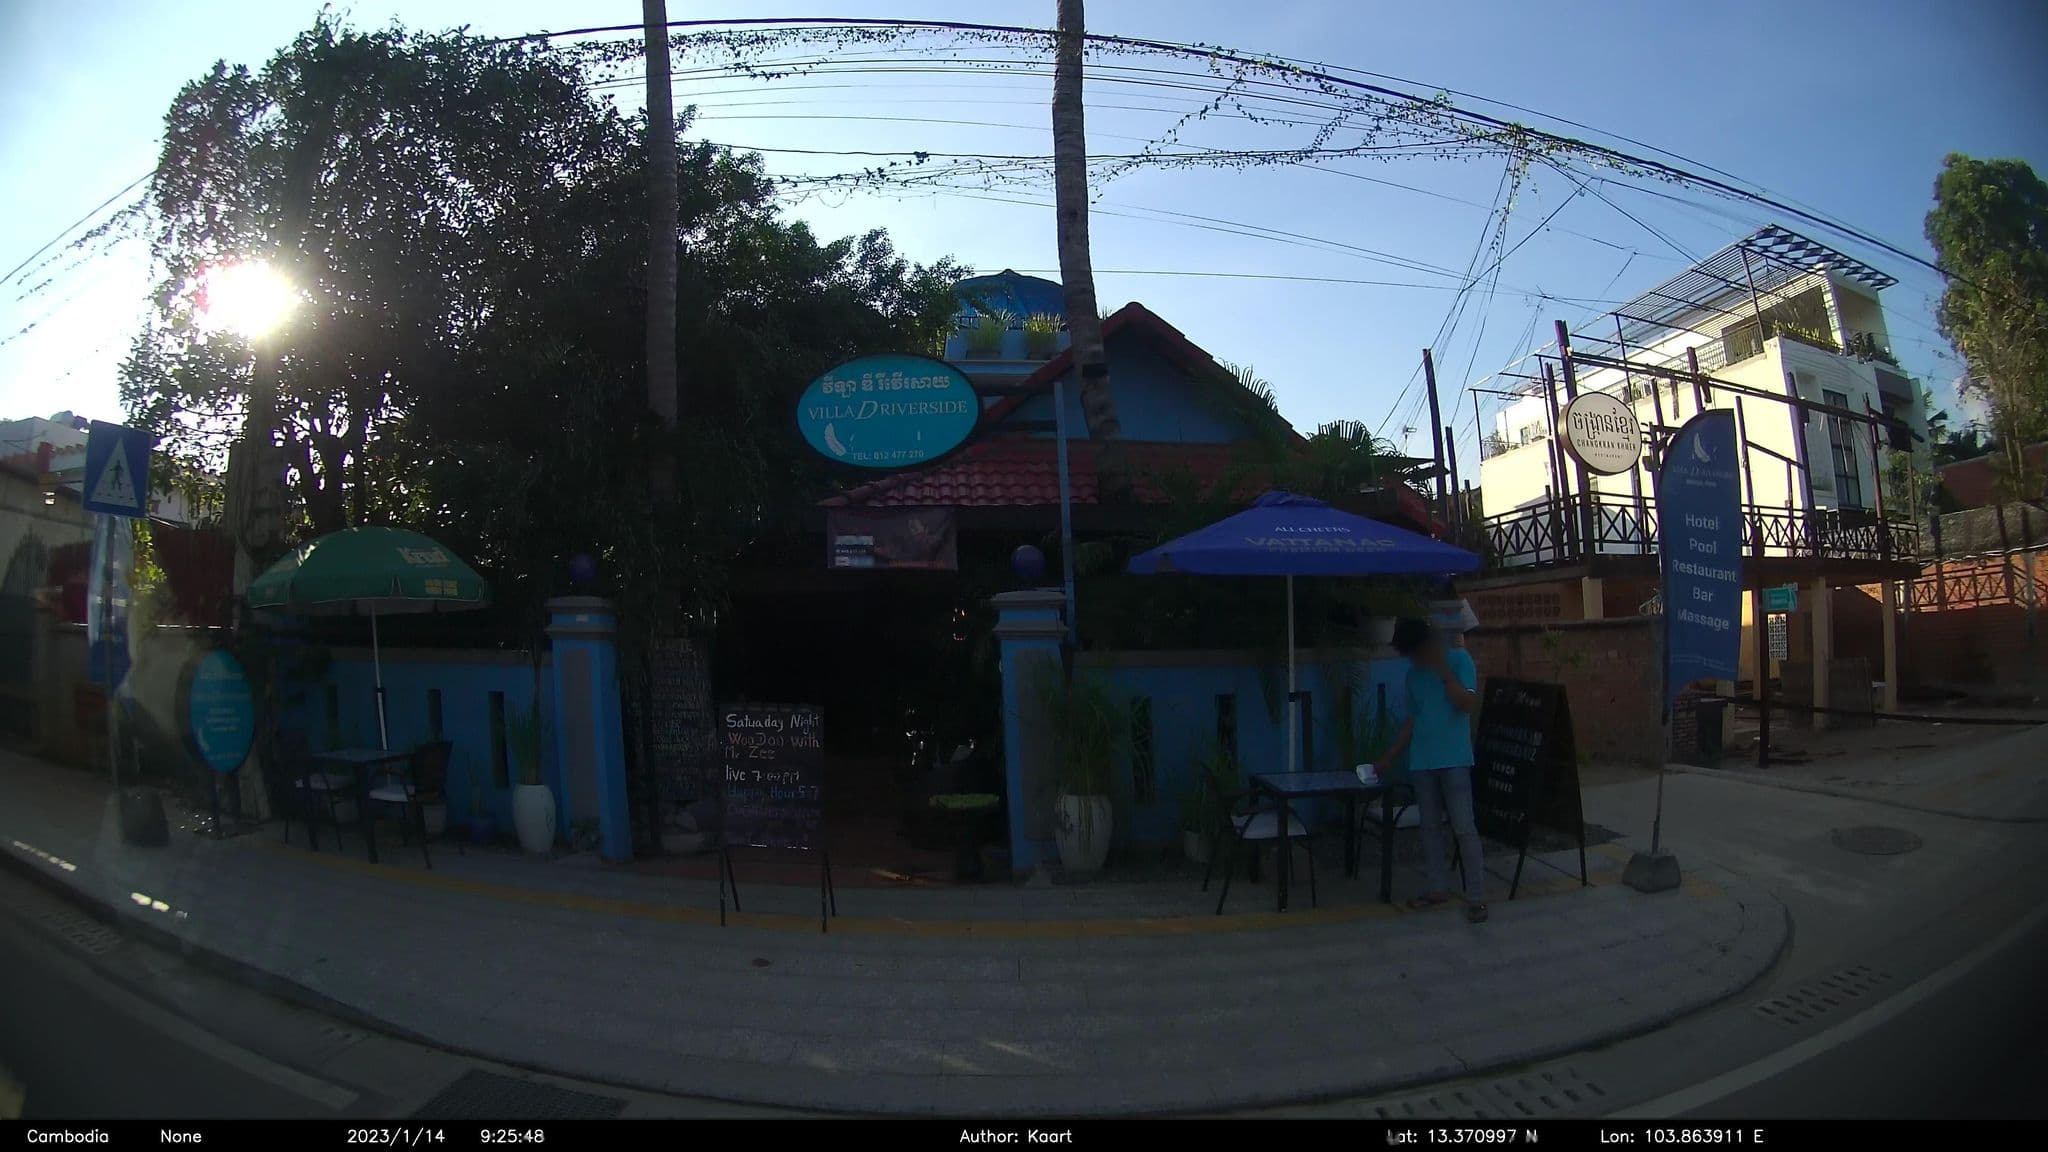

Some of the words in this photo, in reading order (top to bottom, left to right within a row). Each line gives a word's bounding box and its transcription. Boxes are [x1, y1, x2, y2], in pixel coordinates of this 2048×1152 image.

[807, 405, 855, 421] VILLA
[879, 400, 968, 416] RIVERSIDE
[1685, 512, 1720, 531] Hotel
[1689, 537, 1717, 555] Pool
[1672, 559, 1737, 583] Restaurant
[1692, 586, 1713, 603] Bar
[1677, 607, 1730, 632] Massage
[789, 714, 821, 735] Night
[725, 764, 746, 782] live
